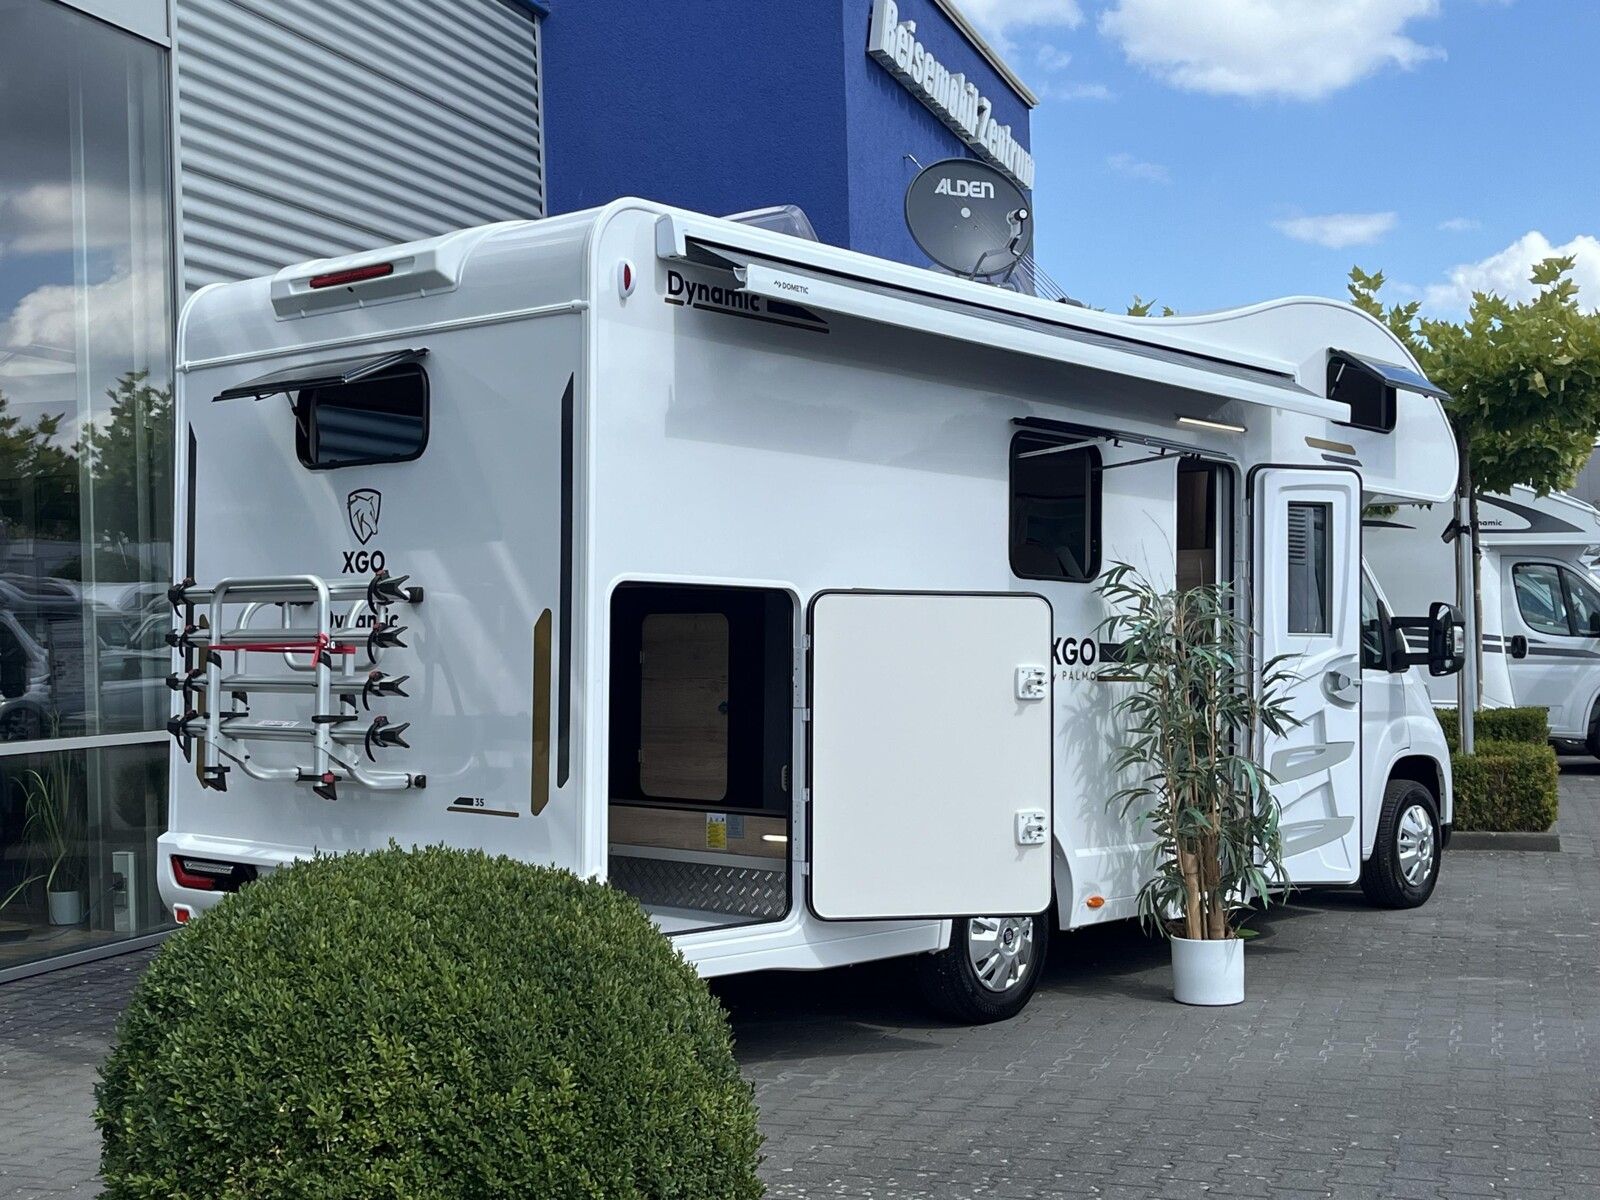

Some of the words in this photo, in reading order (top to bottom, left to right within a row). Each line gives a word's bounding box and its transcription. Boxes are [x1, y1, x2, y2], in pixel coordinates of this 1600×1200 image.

[934, 177, 995, 199] ALDEN
[667, 270, 761, 312] Dynamic
[782, 281, 809, 295] DOMETIC
[342, 550, 385, 574] XGO
[1062, 670, 1097, 682] PALMO
[475, 797, 485, 807] 35
